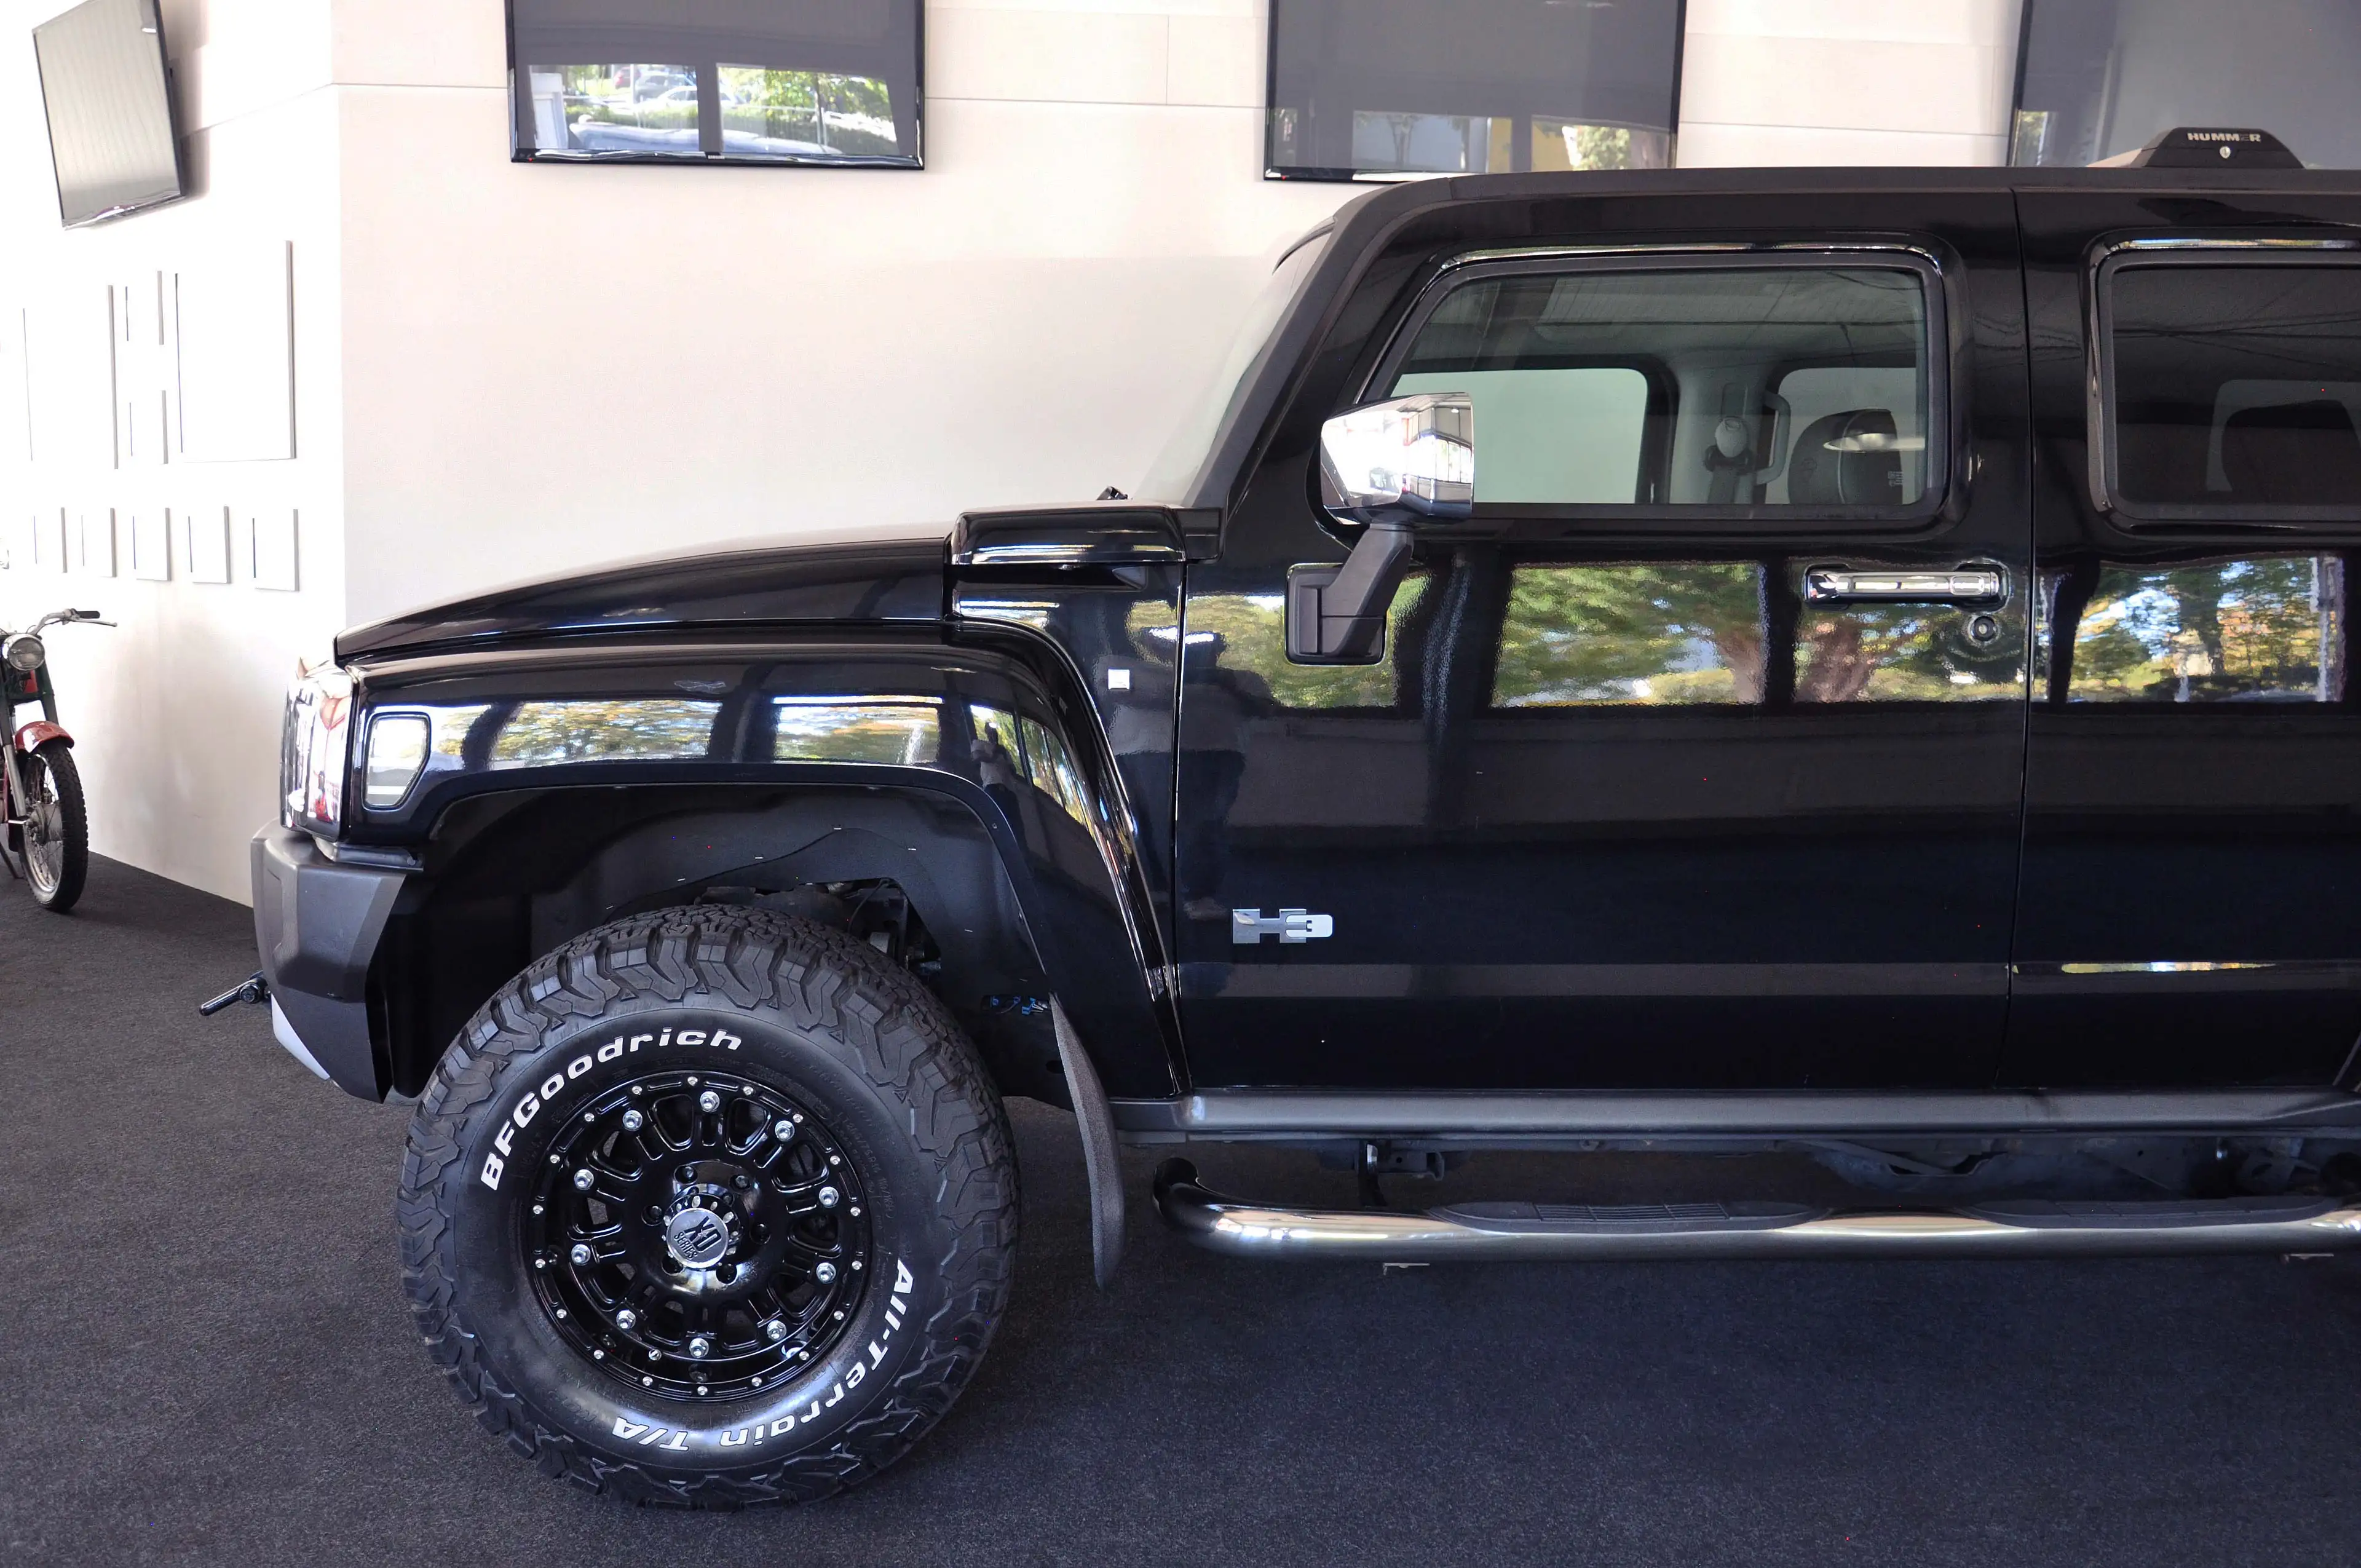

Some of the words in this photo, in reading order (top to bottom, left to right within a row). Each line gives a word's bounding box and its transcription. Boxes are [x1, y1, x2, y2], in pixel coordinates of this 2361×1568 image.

[2187, 133, 2261, 142] HUMMER
[1233, 908, 1333, 943] H3
[480, 1027, 743, 1191] BFGoodrich
[674, 1232, 698, 1259] SERIES
[718, 1259, 914, 1447] All-Terrain
[612, 1416, 689, 1452] T/A
